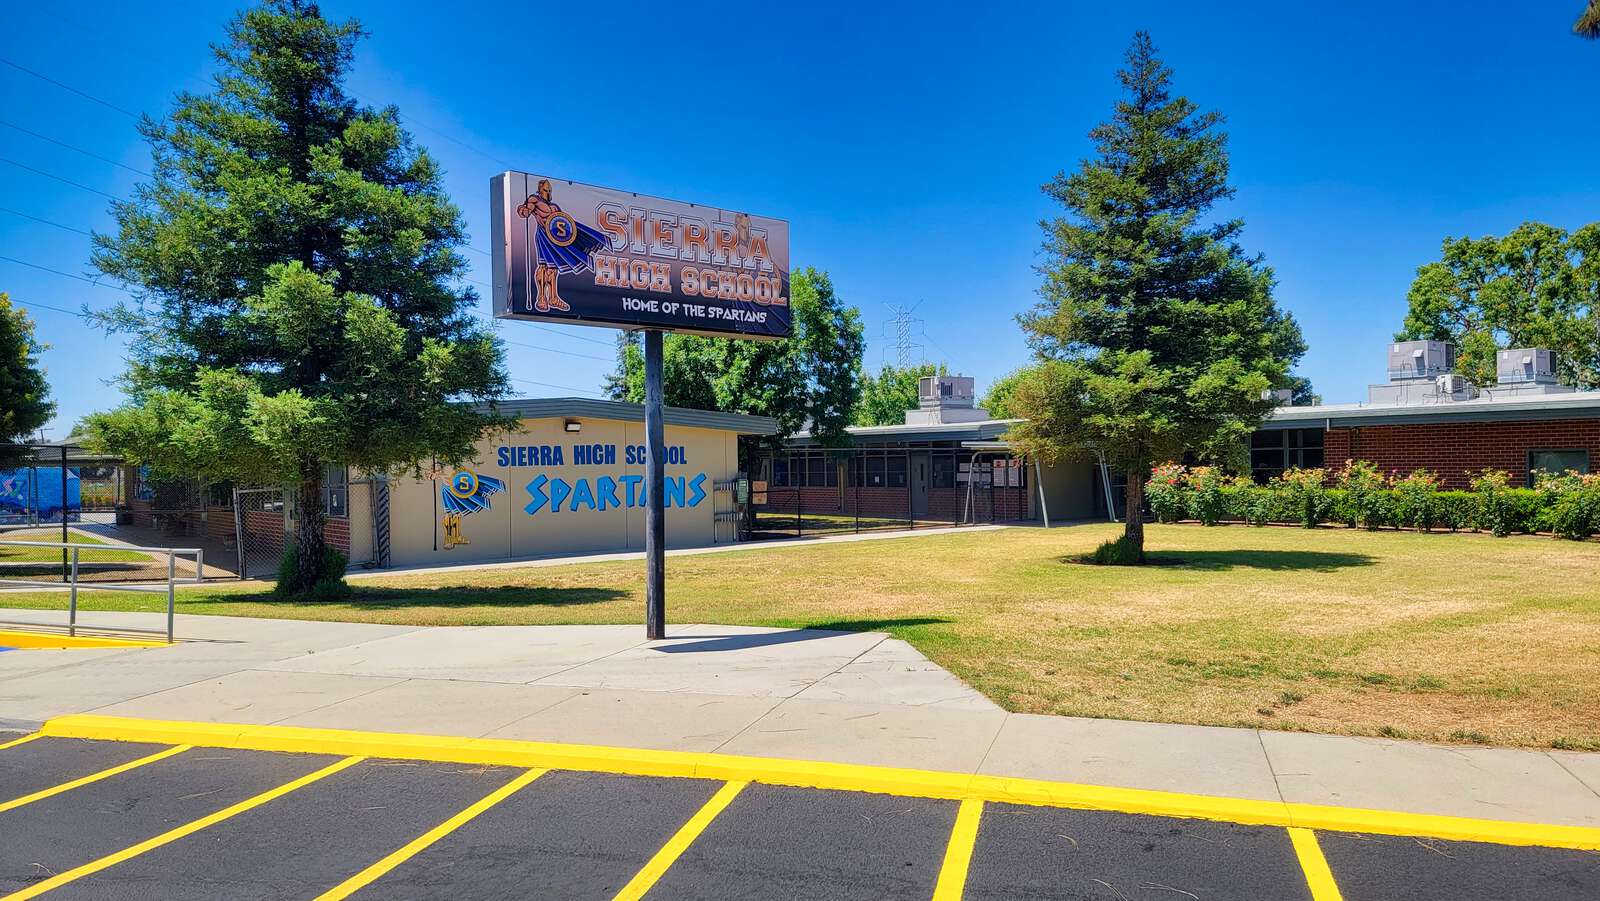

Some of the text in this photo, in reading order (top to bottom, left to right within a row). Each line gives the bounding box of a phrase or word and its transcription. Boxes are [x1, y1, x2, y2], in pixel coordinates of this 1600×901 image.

[595, 201, 773, 272] SIERRA
[595, 254, 787, 306] HIGH SCHOOL
[622, 297, 768, 323] HOME OF THE SPARTANS
[497, 443, 688, 467] SIERRA HIGH SCOL
